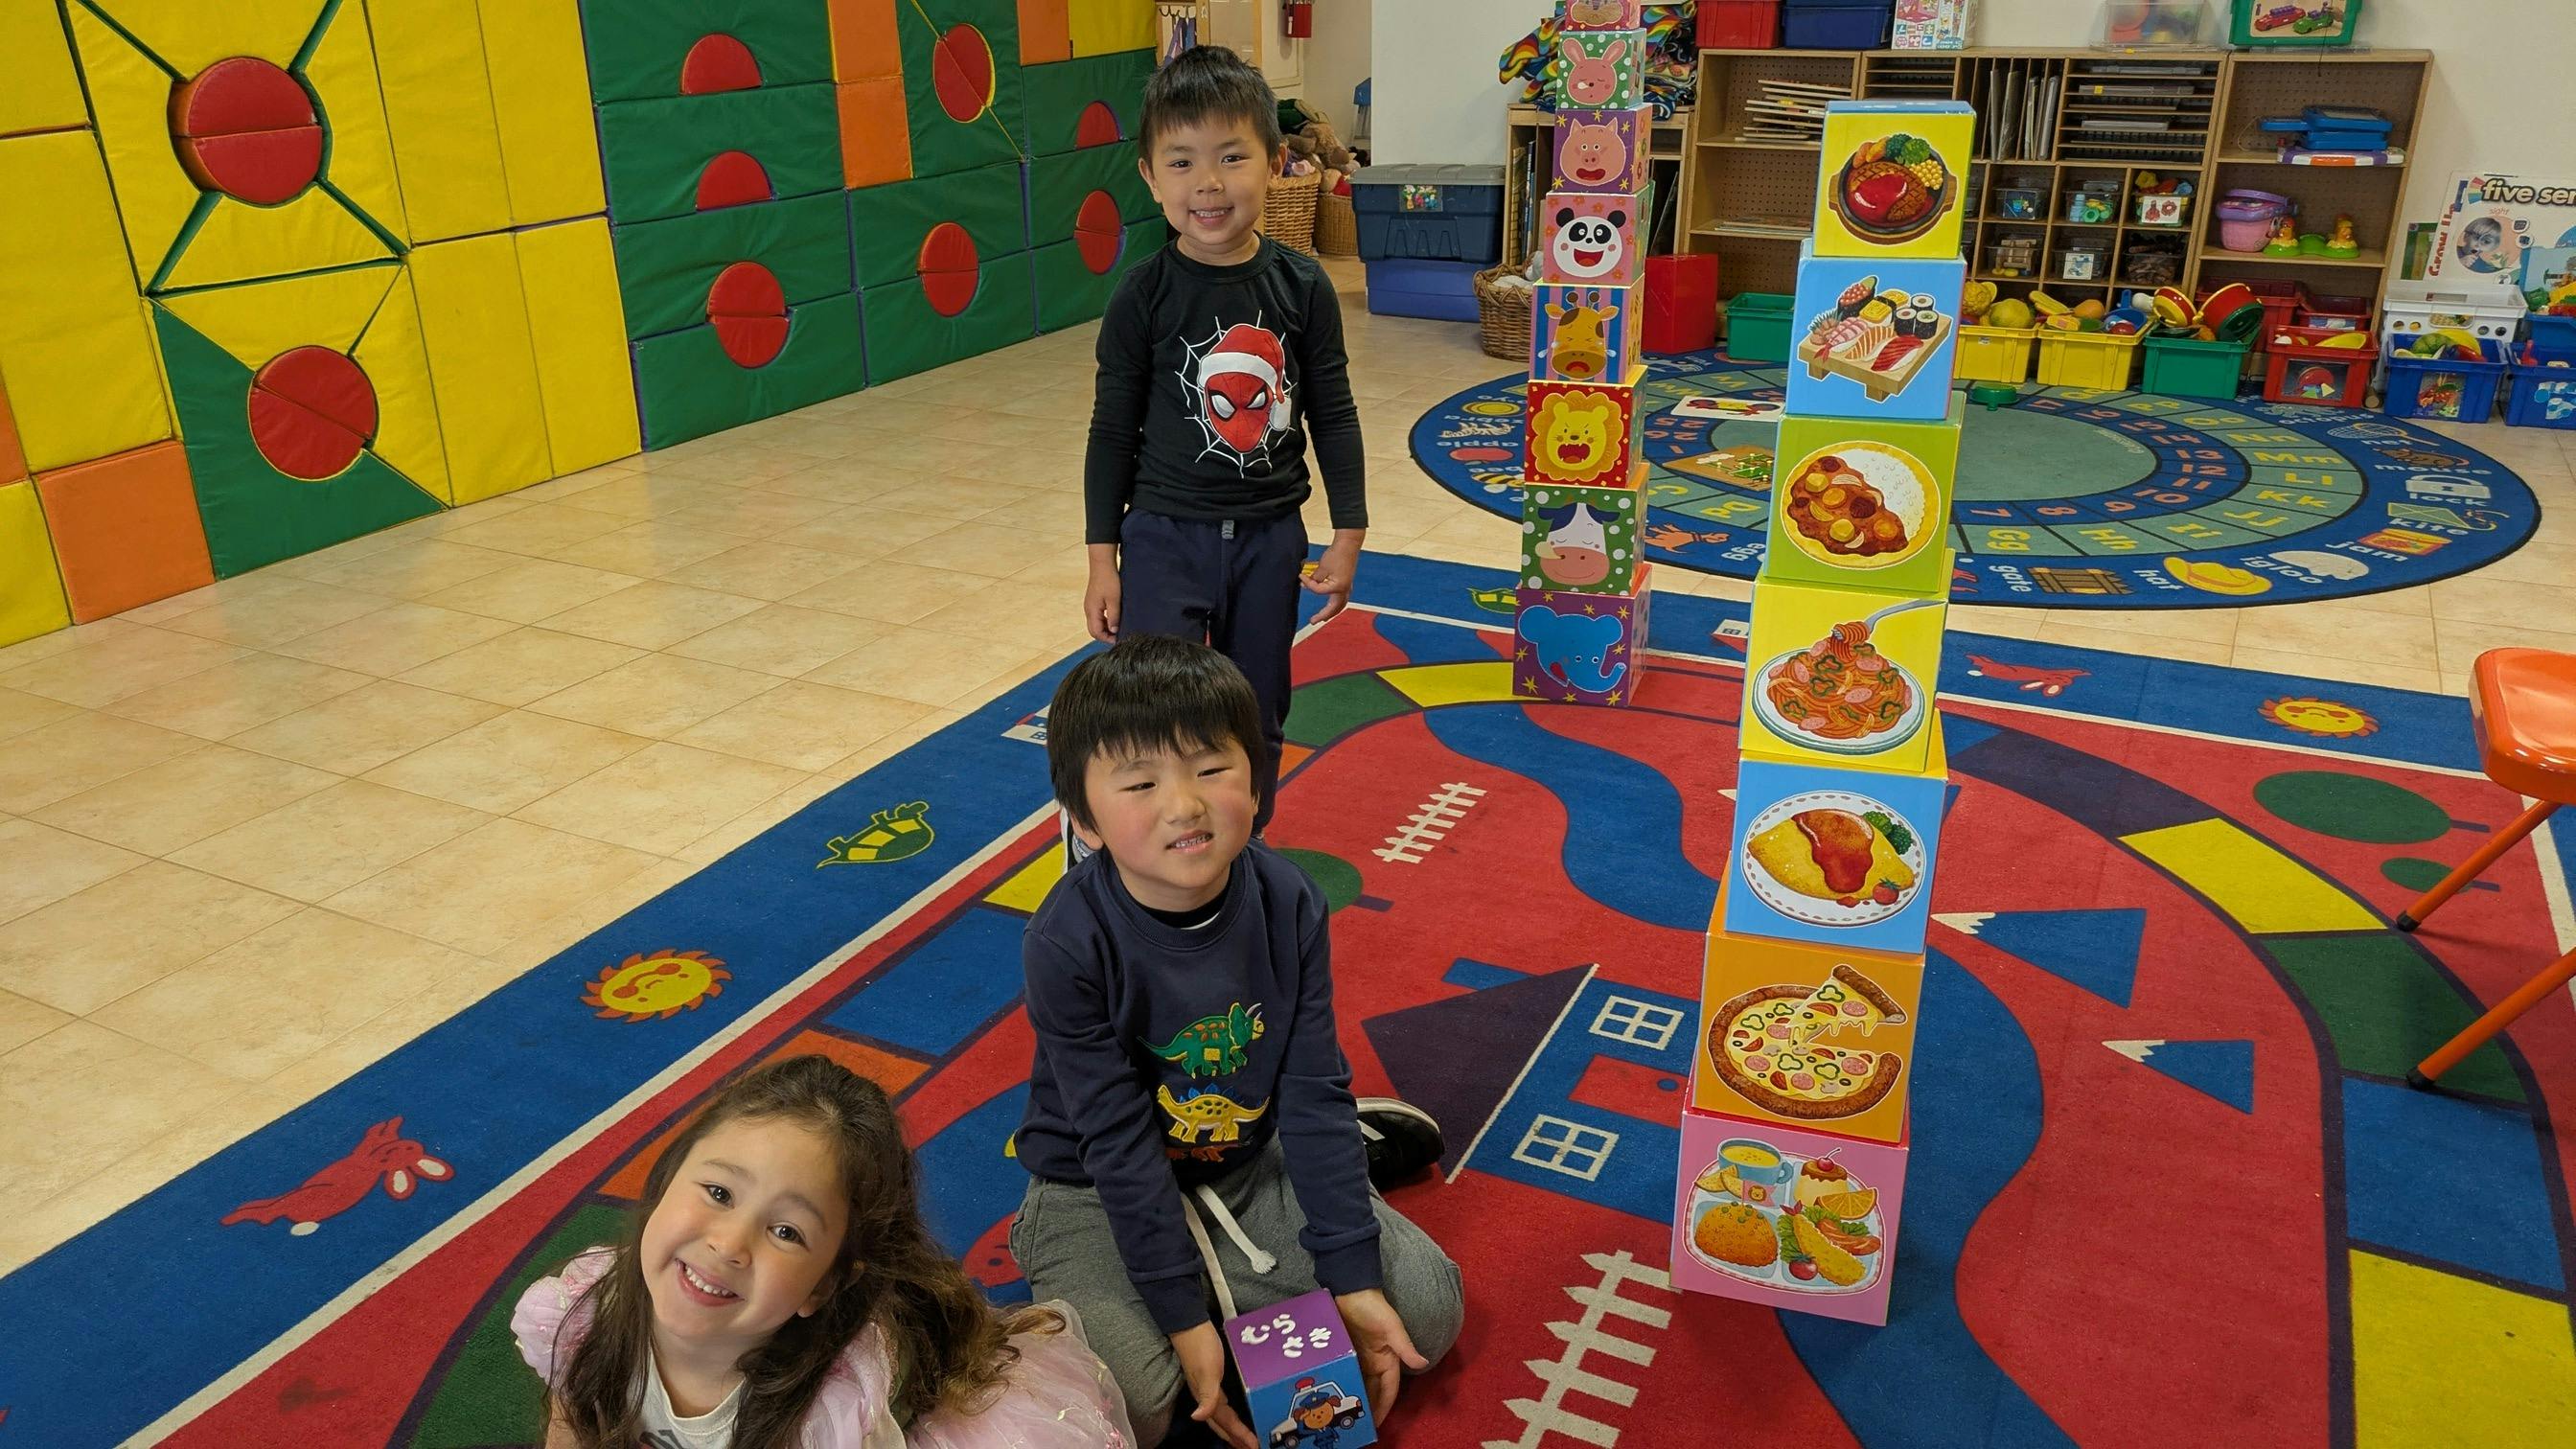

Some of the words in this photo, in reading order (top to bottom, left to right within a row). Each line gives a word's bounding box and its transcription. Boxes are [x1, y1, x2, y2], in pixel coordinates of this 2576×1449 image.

[2481, 178, 2535, 204] five
[2027, 399, 2064, 410] 17
[2075, 409, 2121, 420] 16
[2183, 417, 2246, 426] Oo
[2278, 412, 2374, 425] octopus
[1653, 417, 1709, 428] 25
[2119, 421, 2168, 431] 15
[1644, 430, 1698, 441] 26
[2151, 434, 2203, 445] 14
[2226, 433, 2301, 443] Nn
[2176, 448, 2224, 460] 13
[2253, 451, 2344, 464] Mm
[2182, 464, 2227, 476] 12
[2374, 464, 2492, 475] mouse
[2172, 477, 2212, 491] 11
[2285, 472, 2334, 486] Ll
[2132, 489, 2190, 503] 10
[2256, 490, 2331, 508] Kk
[2408, 493, 2489, 507] lock
[1701, 501, 1761, 518] Dd
[1970, 508, 2012, 518] 7
[2036, 506, 2078, 516] 8
[2104, 501, 2136, 512] 9
[2223, 511, 2289, 527] Jj
[2167, 523, 2222, 539] Ii
[2389, 518, 2469, 536] kite
[1987, 529, 2032, 551] Gg
[2078, 528, 2139, 550] Hh
[1721, 542, 1765, 562] egg
[2325, 541, 2407, 562] jam
[2240, 556, 2322, 584] igloo
[1989, 565, 2033, 593] gate
[2132, 569, 2184, 591] hat
